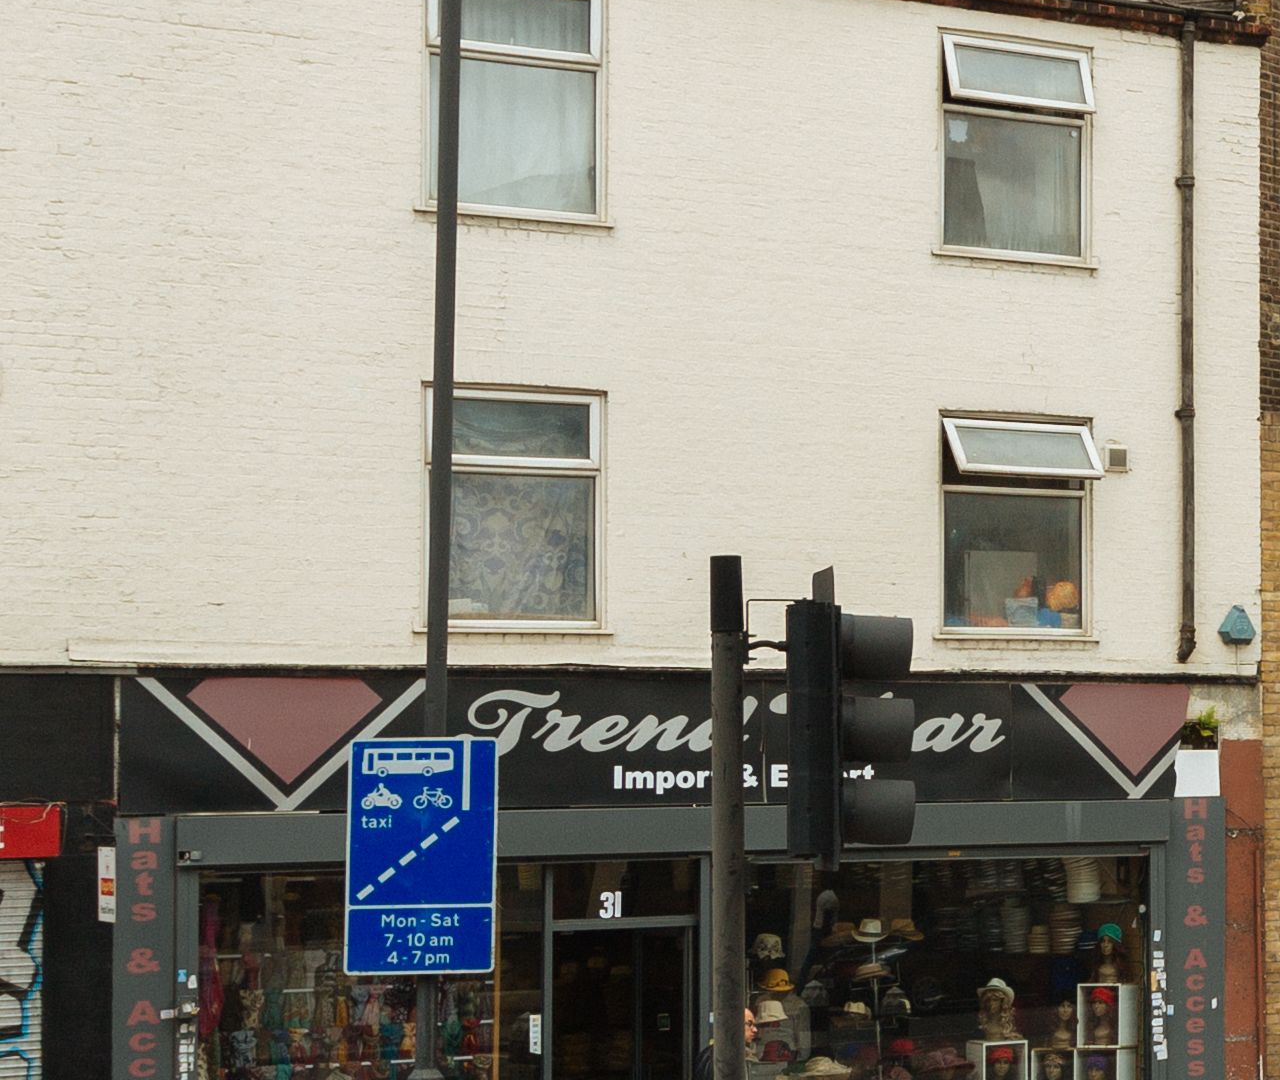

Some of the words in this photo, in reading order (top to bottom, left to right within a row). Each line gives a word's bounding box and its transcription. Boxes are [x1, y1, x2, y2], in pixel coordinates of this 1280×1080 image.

[614, 765, 713, 794] Impor
[361, 815, 392, 829] taxi
[1183, 797, 1207, 885] Hats
[128, 819, 162, 922] Hats
[599, 891, 622, 918] 31
[1183, 905, 1207, 928] &
[381, 914, 416, 928] Mon
[431, 913, 459, 928] Sat
[430, 934, 453, 946] am
[126, 948, 161, 975] &
[425, 952, 449, 966] pm
